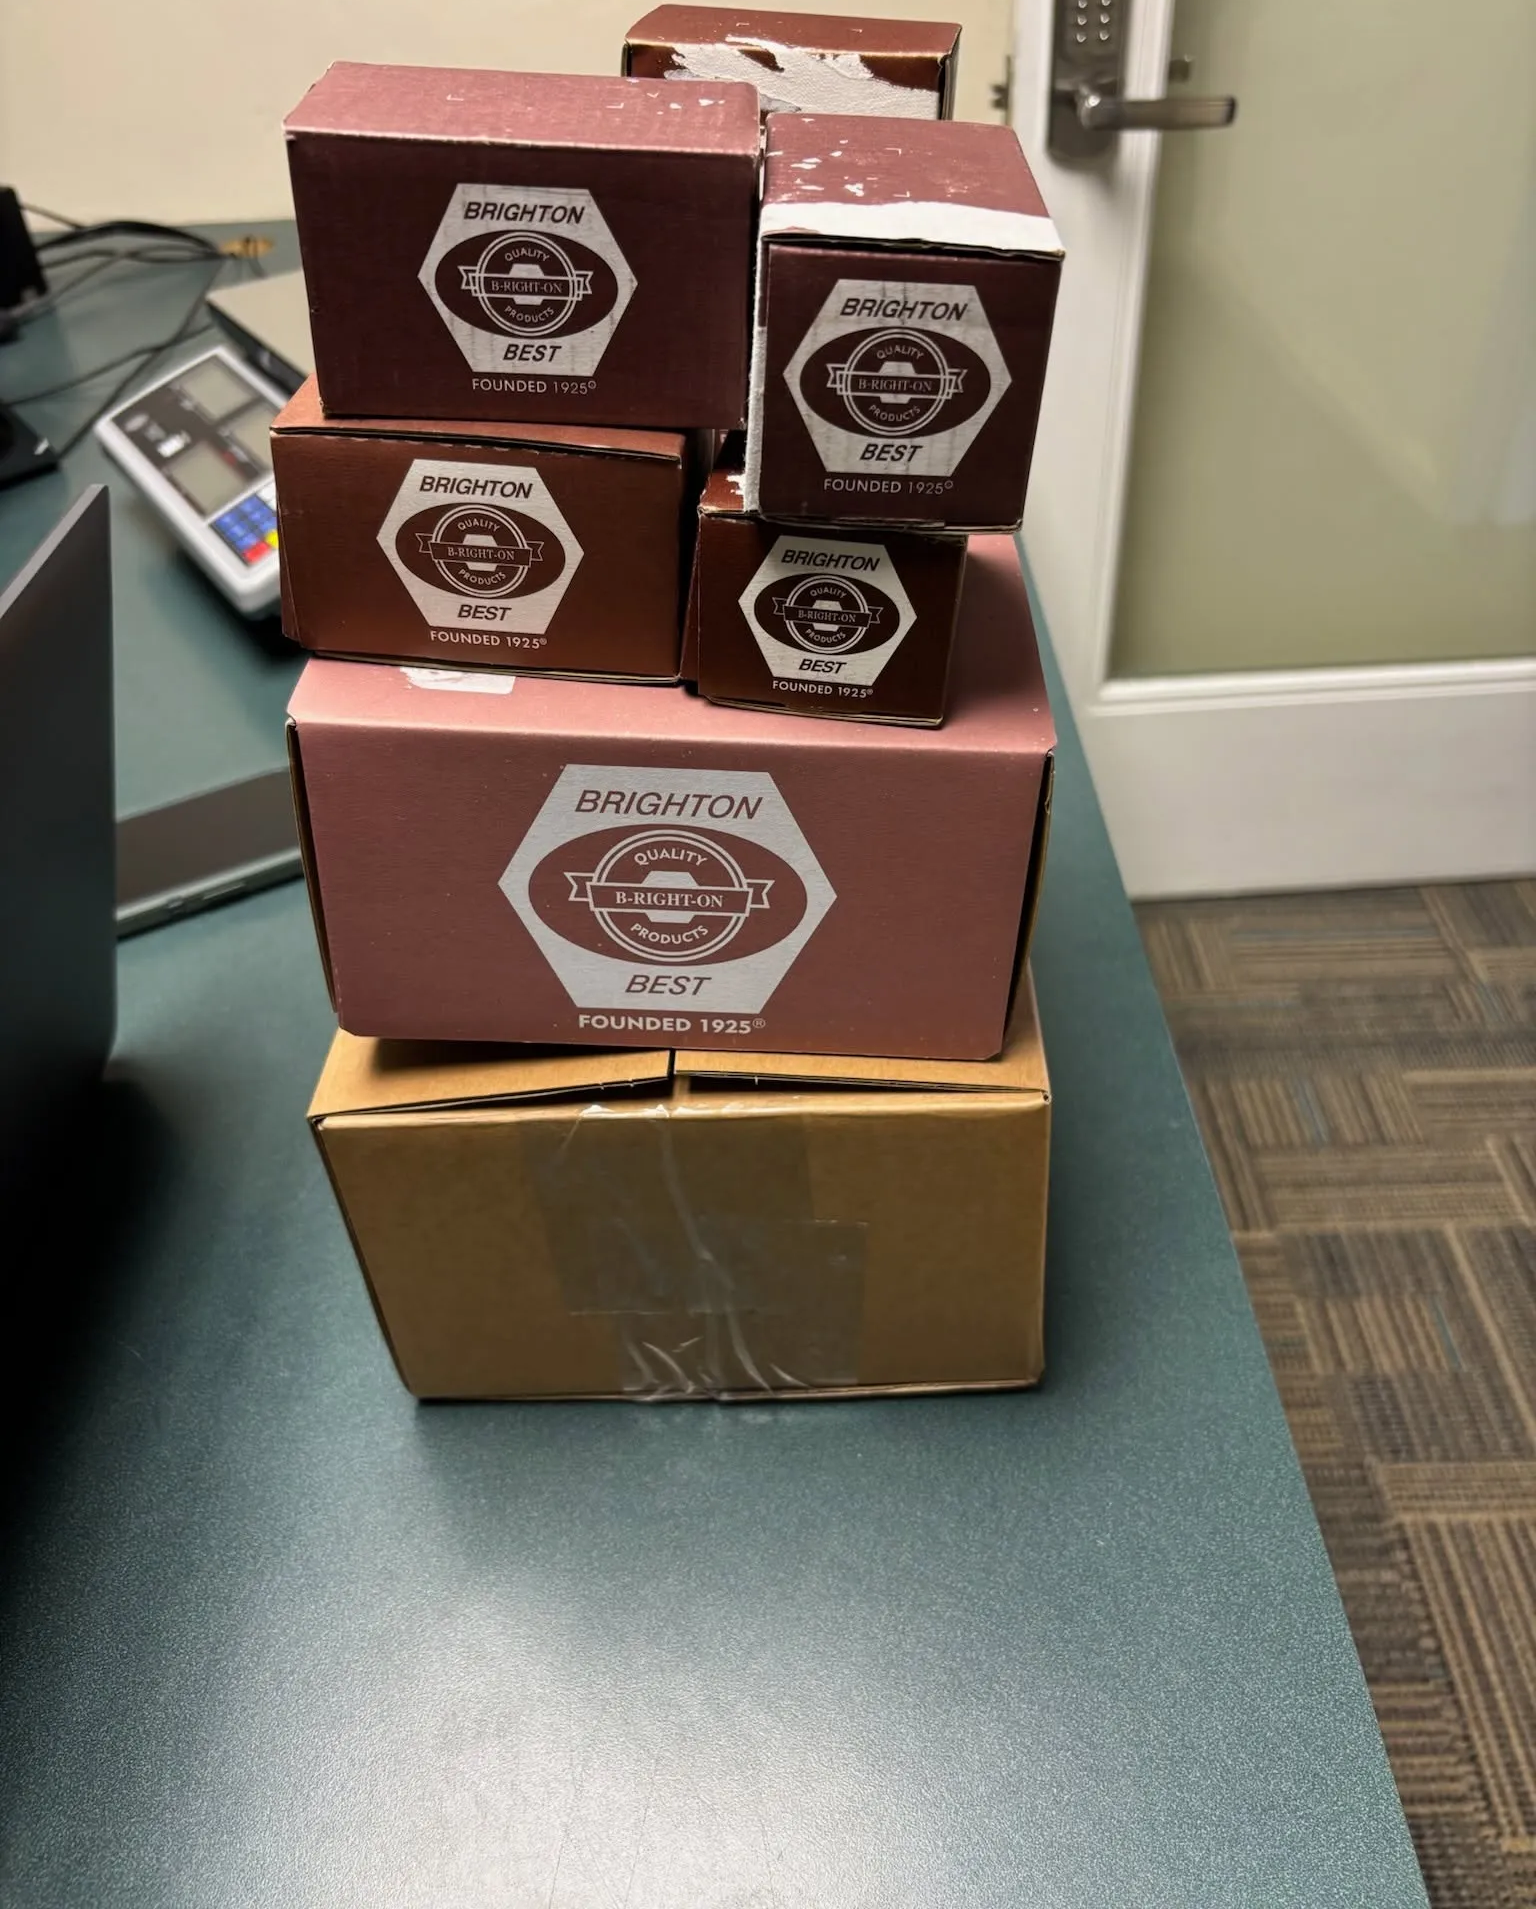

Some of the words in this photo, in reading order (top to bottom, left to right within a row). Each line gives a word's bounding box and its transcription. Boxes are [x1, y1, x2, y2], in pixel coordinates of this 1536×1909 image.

[464, 202, 585, 224] BRIGHTON
[504, 248, 550, 262] QUALITY
[491, 280, 562, 294] B-RIGHT-ON
[505, 306, 554, 323] PRODUCTS
[840, 298, 968, 321] BRIGHTON
[503, 344, 562, 362] BEST
[877, 345, 924, 359] QUALITY
[472, 379, 546, 393] FOUNDED
[858, 378, 932, 391] B-RIGHT-ON
[869, 404, 921, 421] PRODUCTS
[860, 443, 922, 461] BEST
[419, 476, 533, 499] BRIGHTON
[824, 479, 901, 493] FOUNDED
[458, 518, 500, 532] QUALITY
[448, 547, 515, 560] B-RIGHT-ON
[781, 550, 880, 571] BRIGHTON
[458, 569, 506, 585] PRODUCTS
[810, 587, 847, 598] QUALITY
[458, 605, 512, 621] BEST
[798, 610, 856, 622] B-RIGHT-ON
[430, 631, 500, 646] FOUNDED
[805, 629, 846, 643] PRODUCTS
[799, 659, 847, 674] BEST
[773, 680, 832, 694] FOUNDED
[575, 789, 763, 819] BRIGHTON
[634, 848, 708, 866] QUALITY
[615, 891, 723, 907] B-RIGHT-ON
[630, 923, 709, 945] PRODUCTS
[625, 974, 712, 996] BEST
[578, 1014, 691, 1032] FOUNDED
